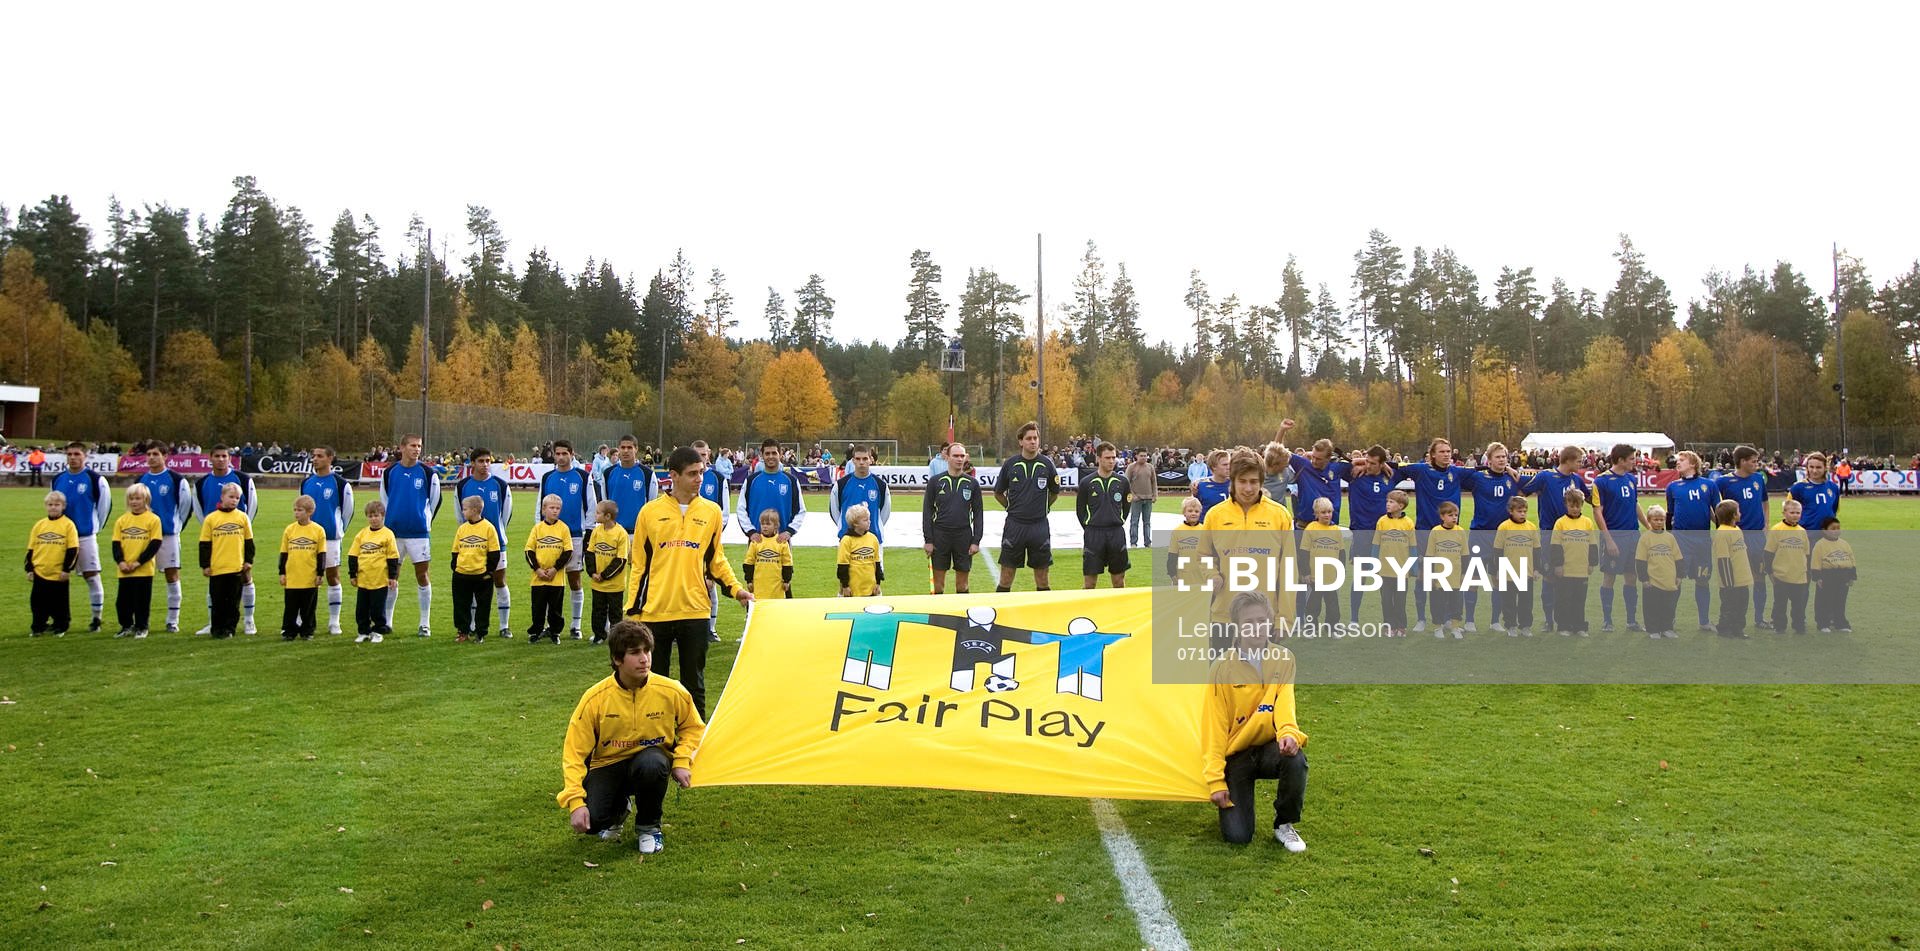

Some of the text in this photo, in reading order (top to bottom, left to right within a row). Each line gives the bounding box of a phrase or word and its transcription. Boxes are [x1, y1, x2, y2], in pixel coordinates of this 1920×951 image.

[167, 459, 178, 468] du
[509, 466, 536, 479] ICA
[1060, 476, 1075, 485] EL
[1437, 480, 1444, 491] 8
[1373, 482, 1380, 493] 6
[1493, 485, 1504, 497] 10
[1621, 486, 1630, 498] 13
[1688, 489, 1700, 500] 14
[1742, 488, 1753, 499] 16
[1815, 493, 1827, 504] 17
[963, 641, 992, 651] UEFA
[830, 690, 1106, 748] Fair Play
[611, 735, 666, 748] INTERSPORT
